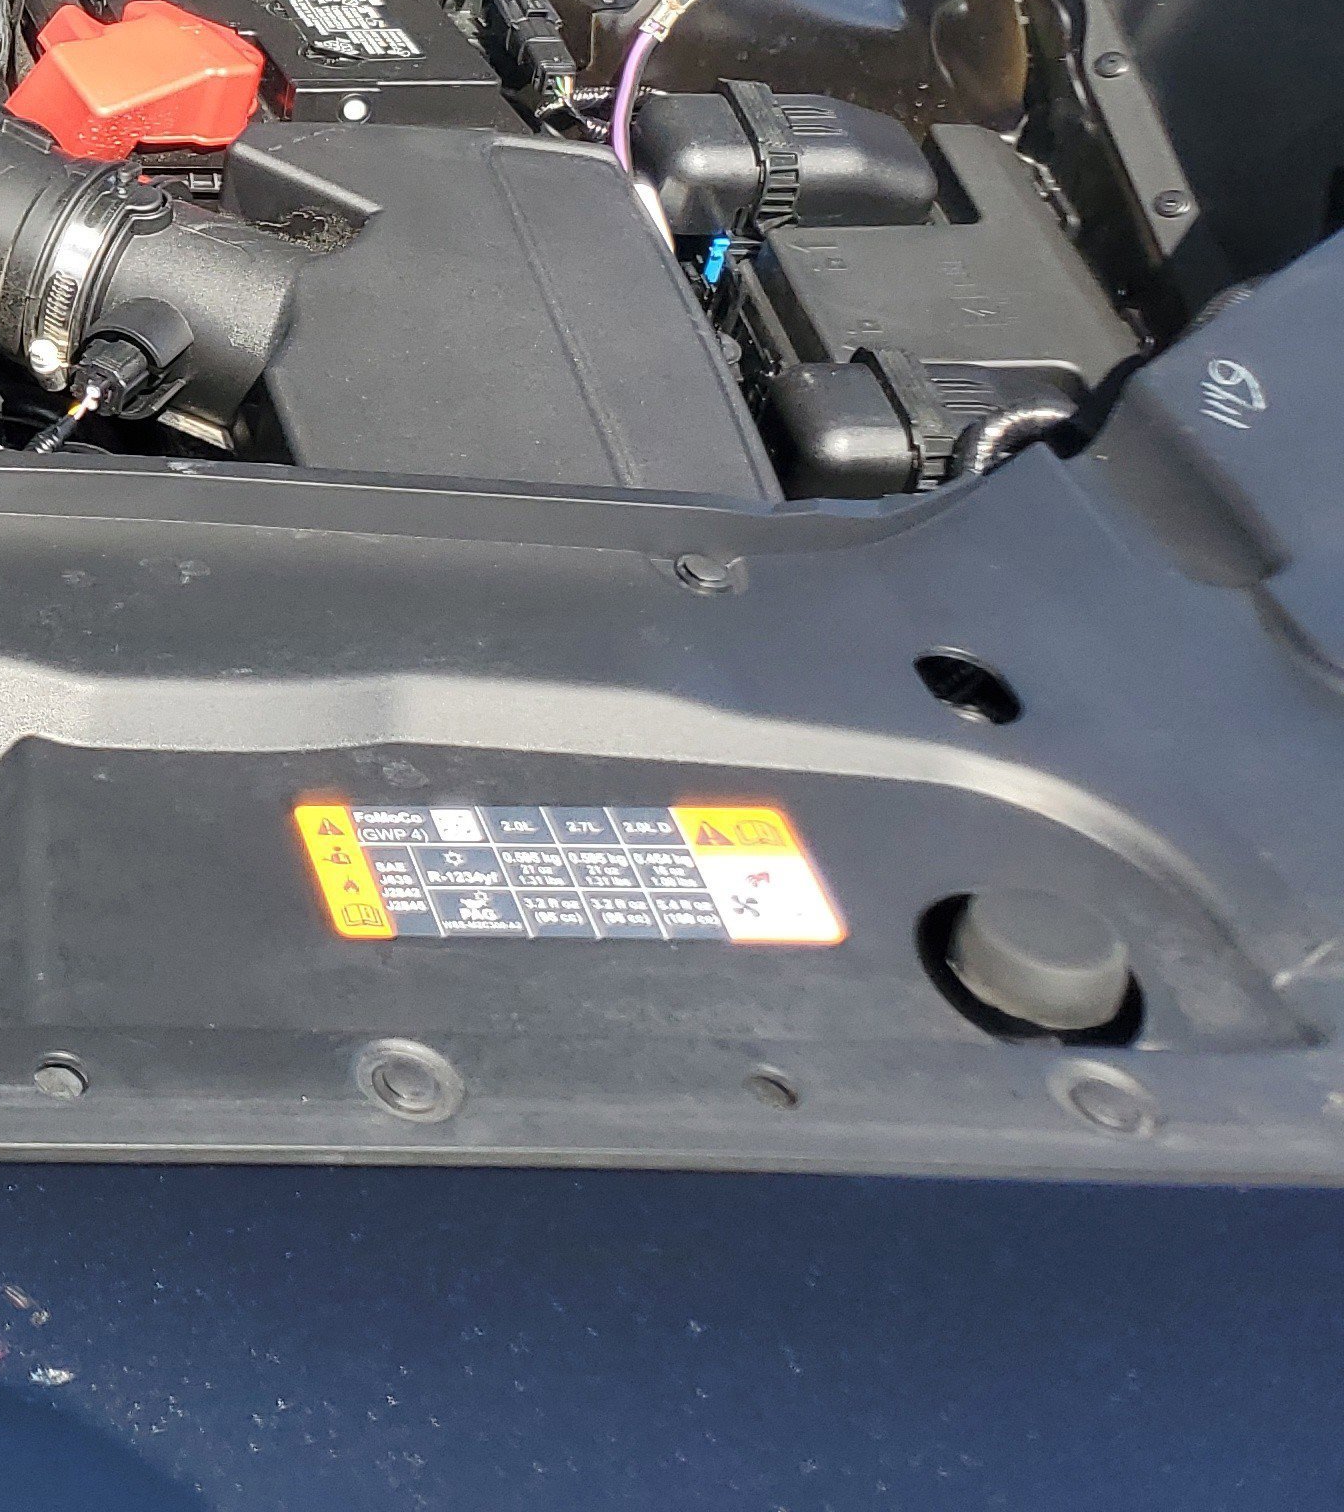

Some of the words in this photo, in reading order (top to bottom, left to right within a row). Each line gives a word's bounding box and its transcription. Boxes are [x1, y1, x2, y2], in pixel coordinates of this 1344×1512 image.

[353, 811, 424, 824] FoMoCo
[500, 820, 536, 833] 2.0L
[565, 820, 603, 833] 2.7L
[658, 822, 672, 834] D
[356, 828, 408, 843] (GWP
[410, 829, 429, 843] 4)
[541, 851, 563, 867] kg
[607, 852, 629, 868] kg
[673, 853, 695, 868] kg
[520, 864, 536, 875] 21
[537, 866, 553, 875] oz
[586, 864, 602, 875] 21
[604, 866, 620, 876] oz
[426, 870, 499, 886] R-1234yf
[524, 897, 548, 910] 3.2
[561, 900, 580, 910] oz
[628, 900, 648, 911] oz
[459, 907, 499, 920] PAG
